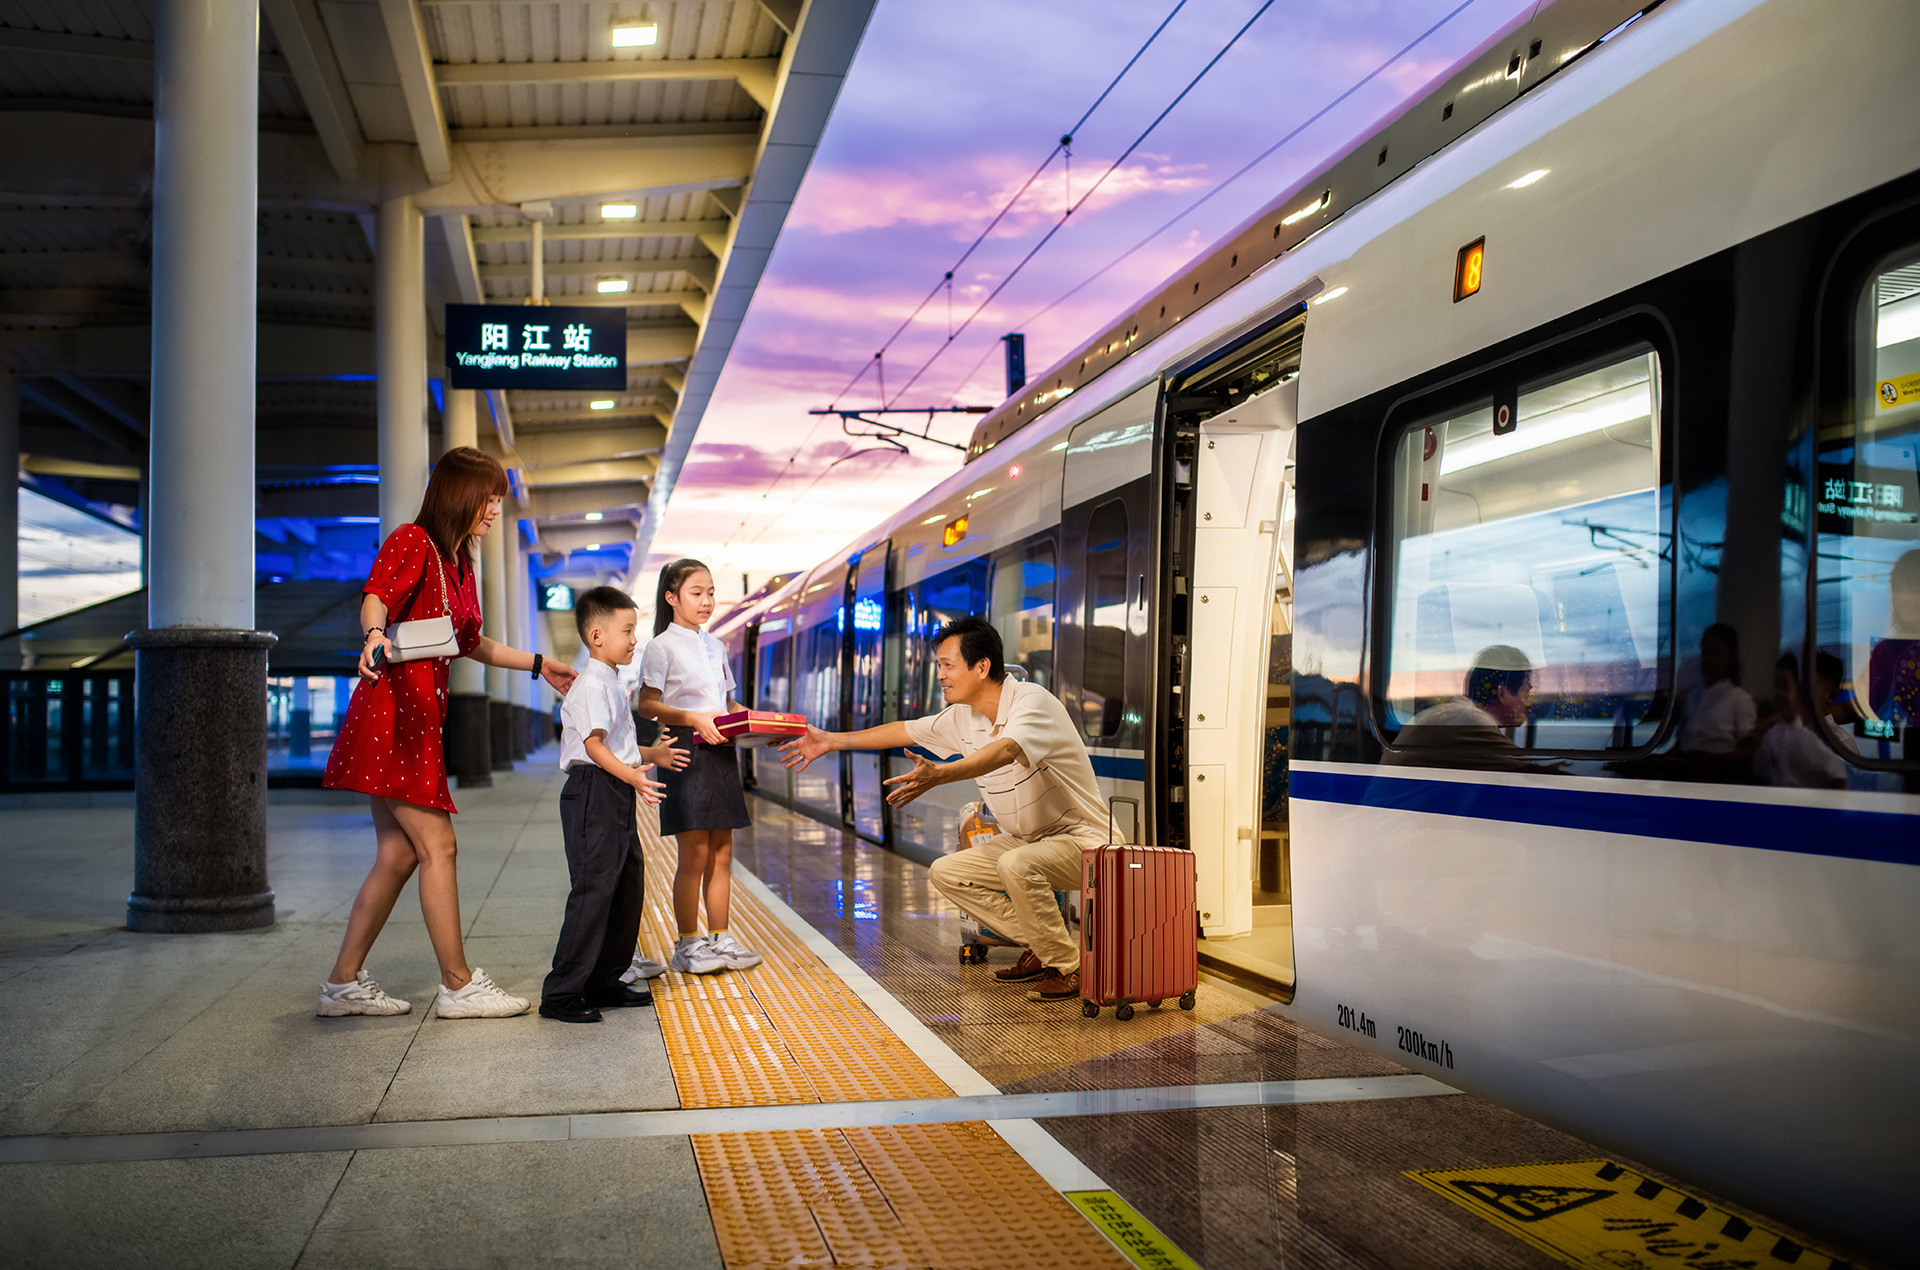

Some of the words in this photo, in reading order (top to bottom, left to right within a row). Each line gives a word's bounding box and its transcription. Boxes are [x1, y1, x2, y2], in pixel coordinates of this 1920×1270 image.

[1468, 252, 1482, 289] 8
[481, 323, 592, 352] 阳江站
[456, 352, 519, 369] Yangjiang
[521, 353, 571, 370] Railway
[572, 354, 618, 368] Station
[1337, 1003, 1377, 1039] 201.4m
[1397, 1025, 1454, 1069] 200km/h
